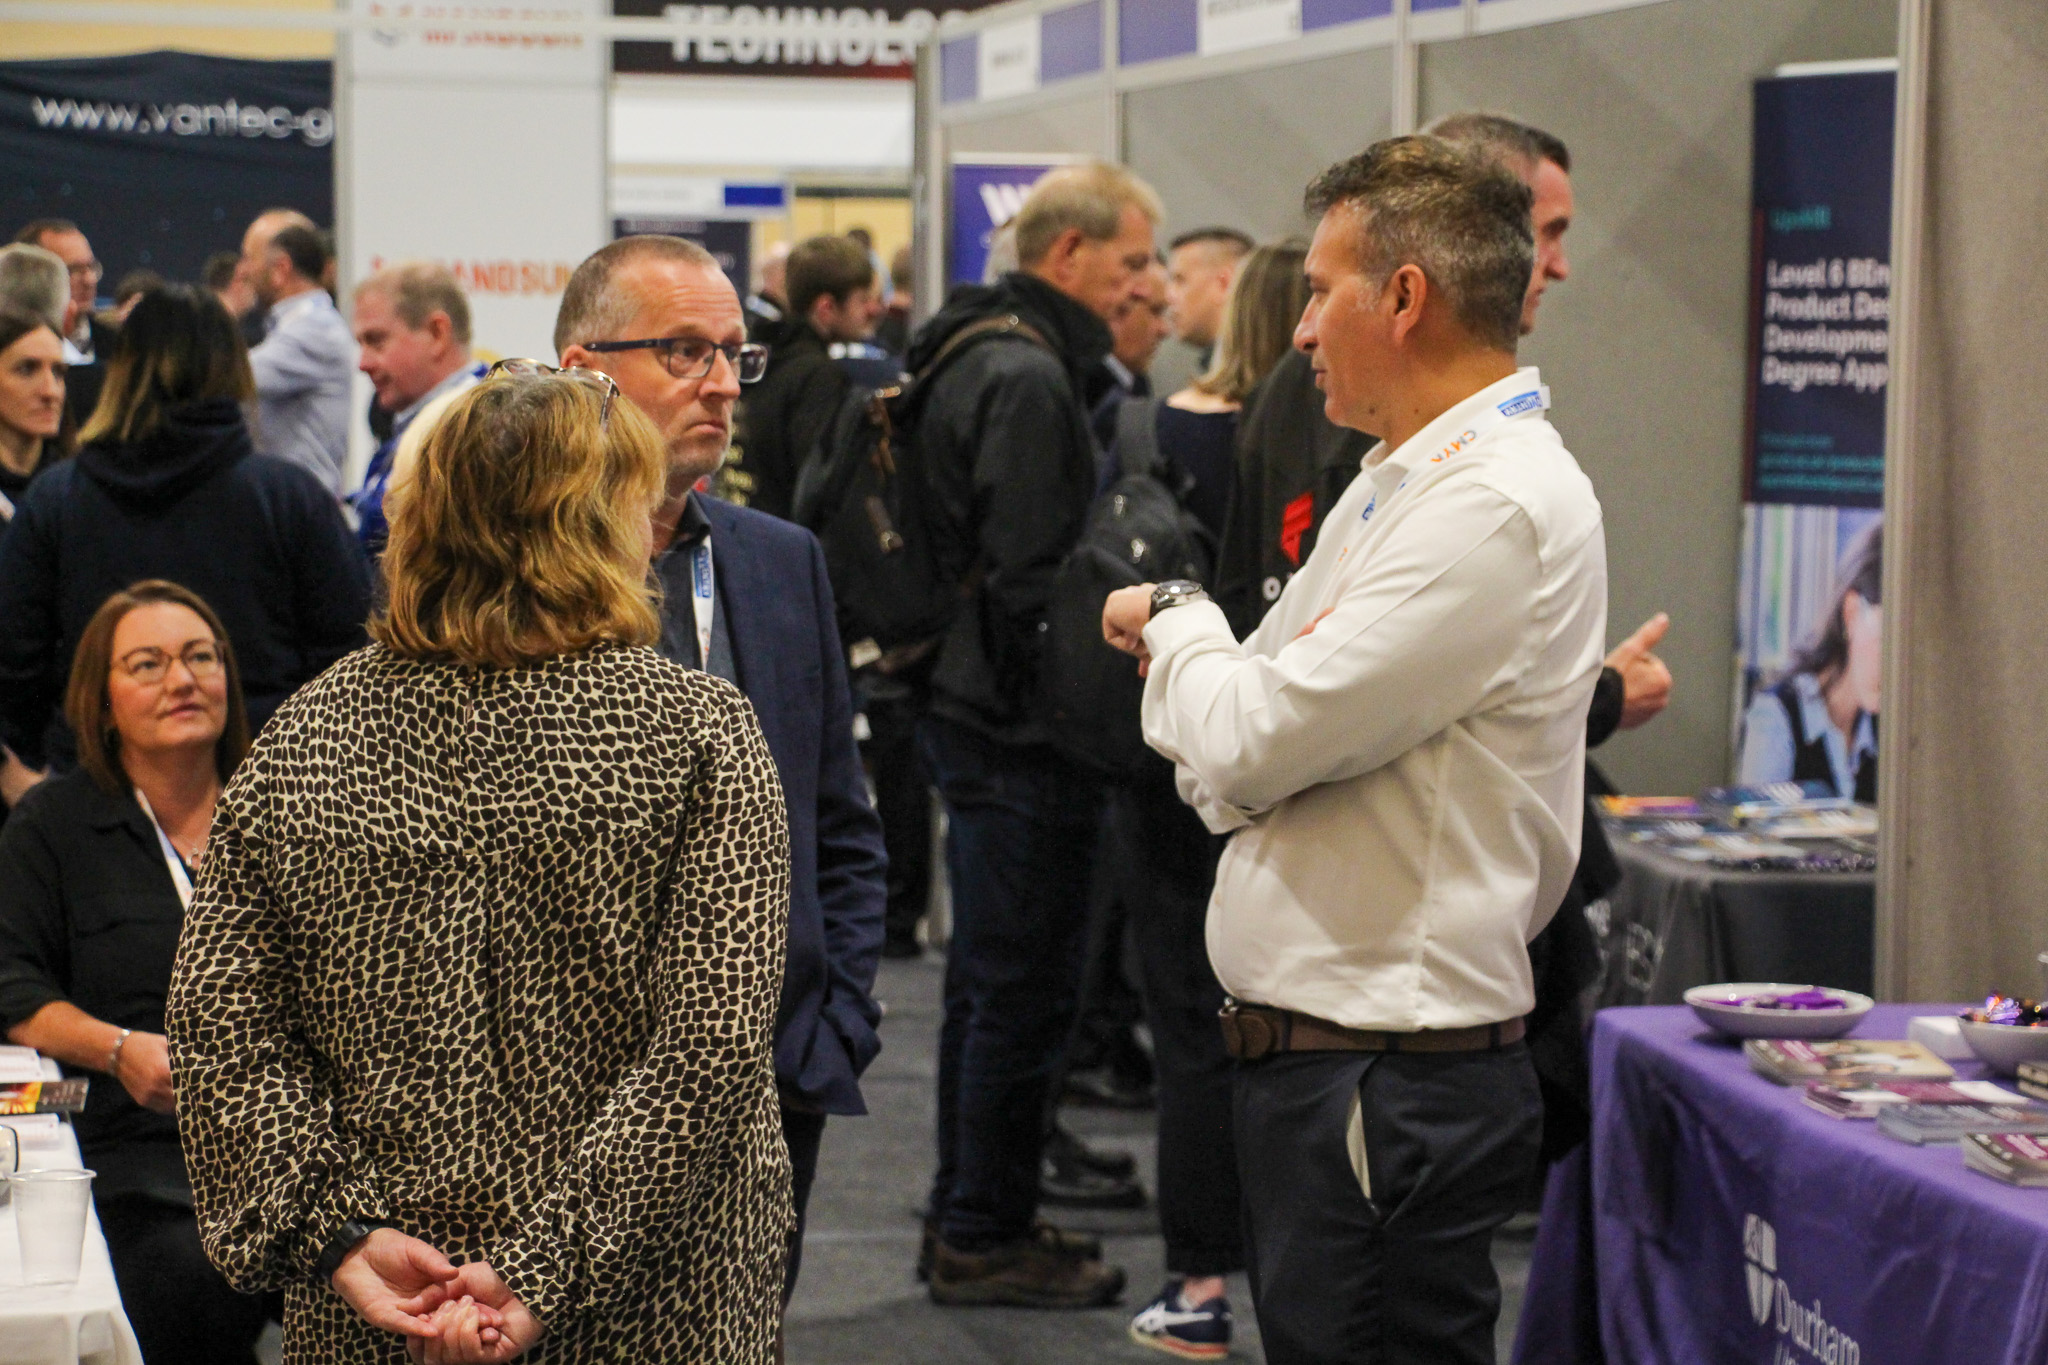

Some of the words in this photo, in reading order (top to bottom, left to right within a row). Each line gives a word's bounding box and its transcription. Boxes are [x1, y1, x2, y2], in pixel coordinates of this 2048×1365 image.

[1766, 257, 1826, 289] Level
[1828, 257, 1845, 289] 6
[1764, 291, 1850, 321] Product
[1761, 355, 1841, 392] Degree
[1775, 1278, 1860, 1365] Durham
